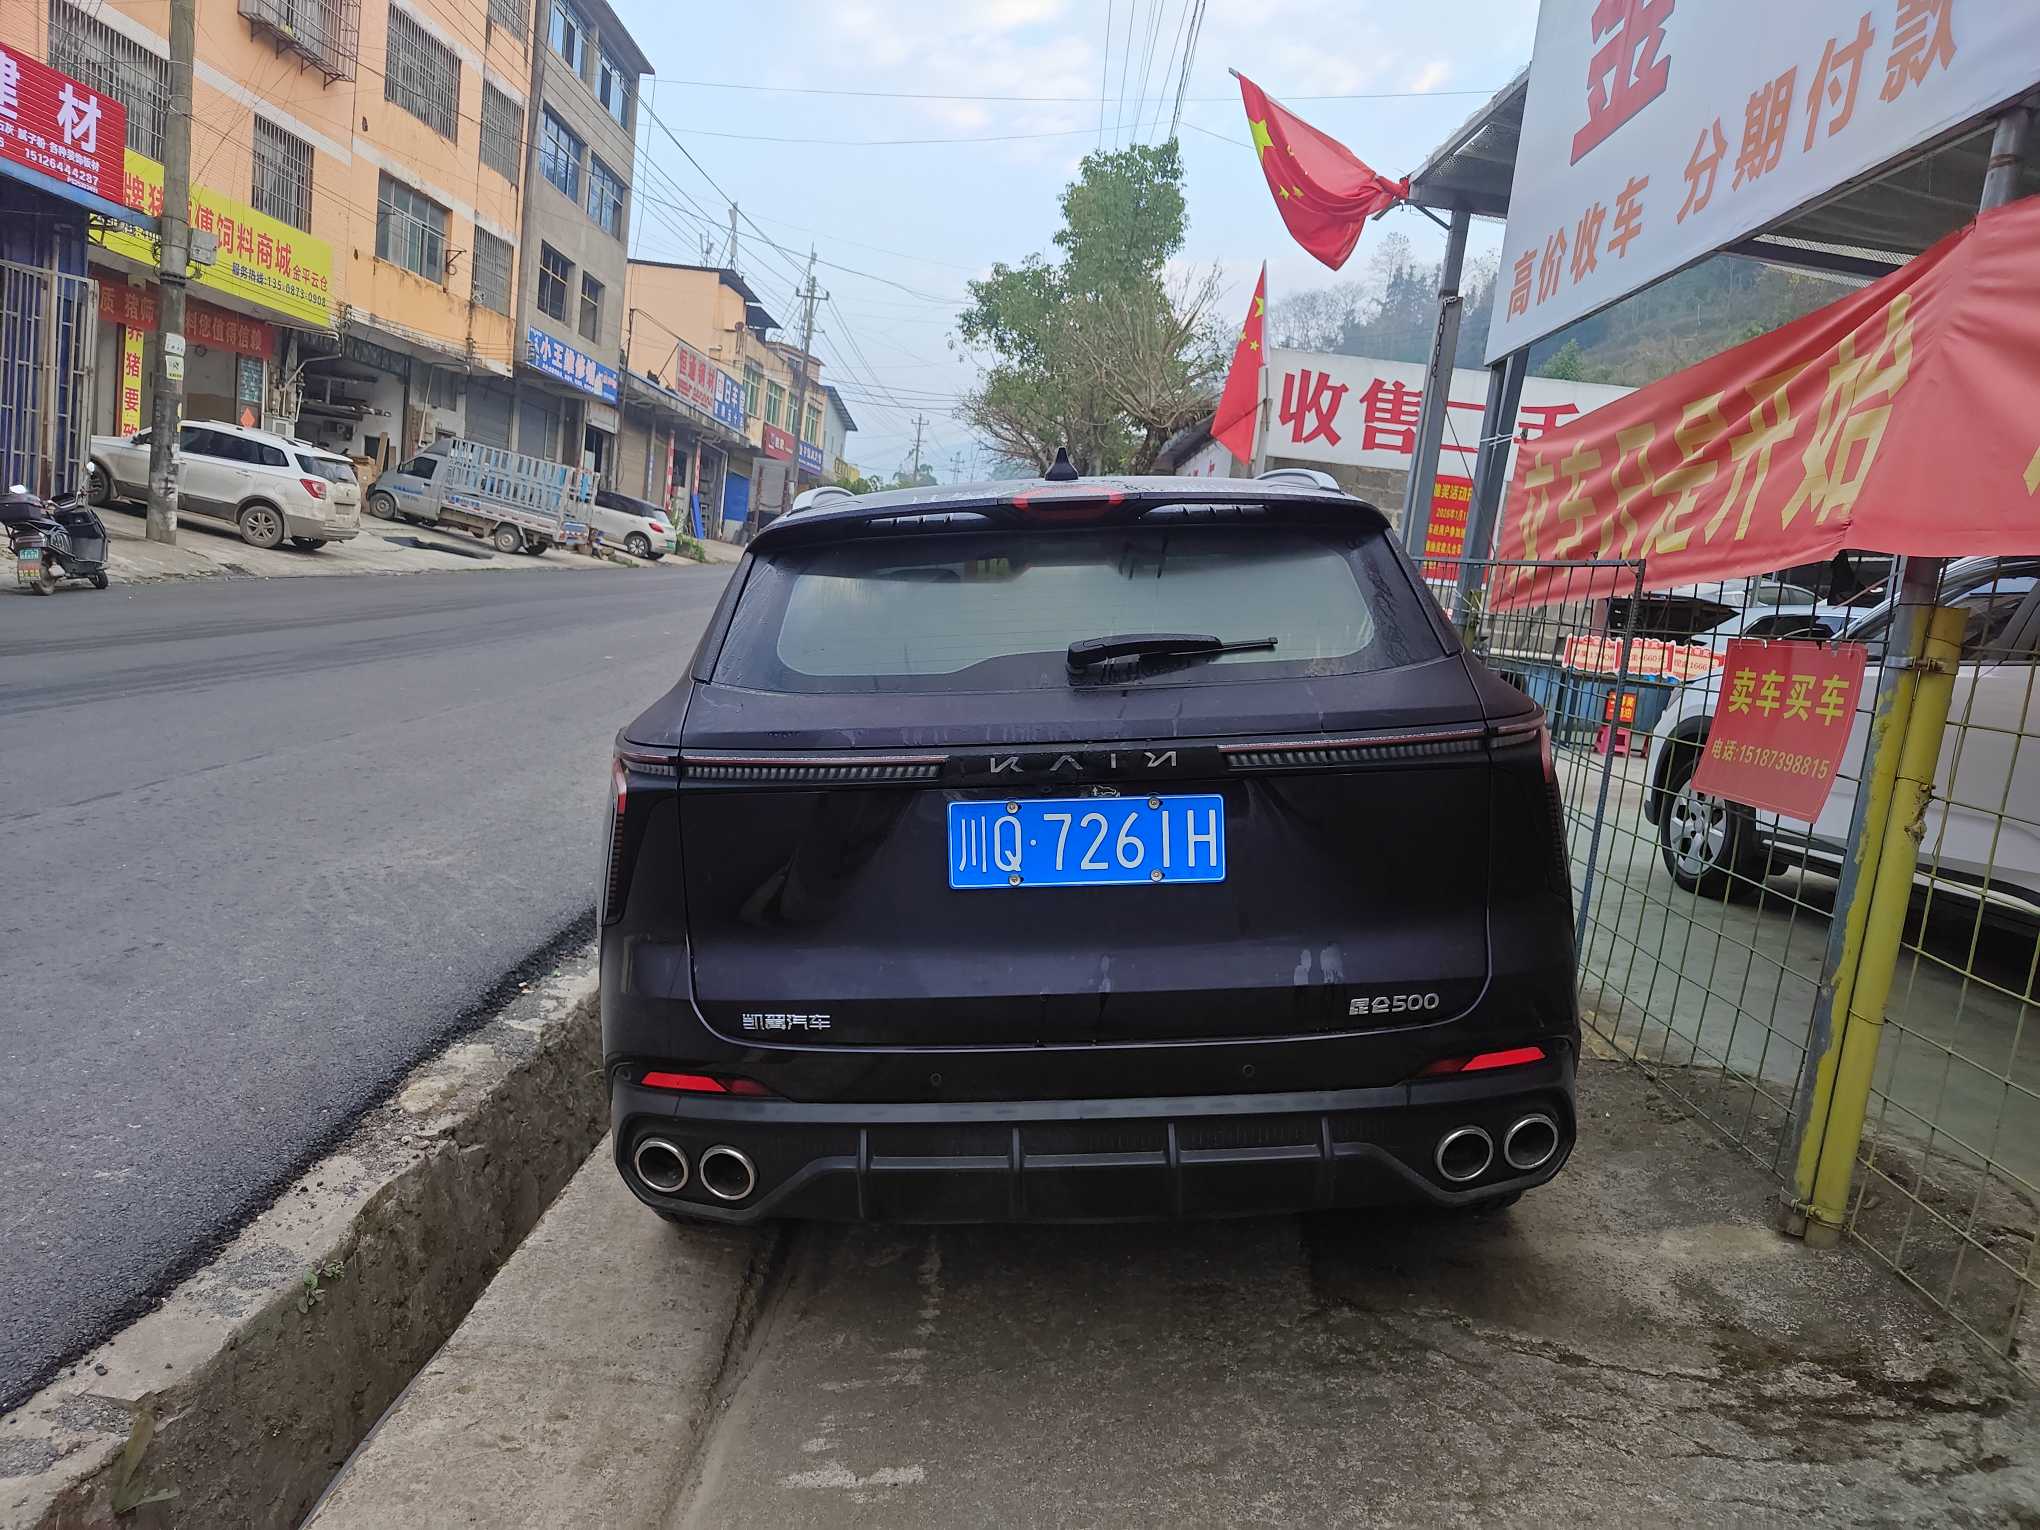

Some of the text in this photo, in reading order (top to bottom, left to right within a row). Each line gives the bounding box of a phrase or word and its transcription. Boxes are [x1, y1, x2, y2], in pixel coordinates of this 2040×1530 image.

[25, 148, 98, 185] 15126444287
[1507, 0, 1957, 323] 高价收车 分期付款
[292, 265, 328, 292] 金平云仓
[1727, 667, 1850, 726] 卖车买车
[1711, 738, 1830, 780] 电话:15187398815
[742, 1013, 832, 1031] 凯翼汽车
